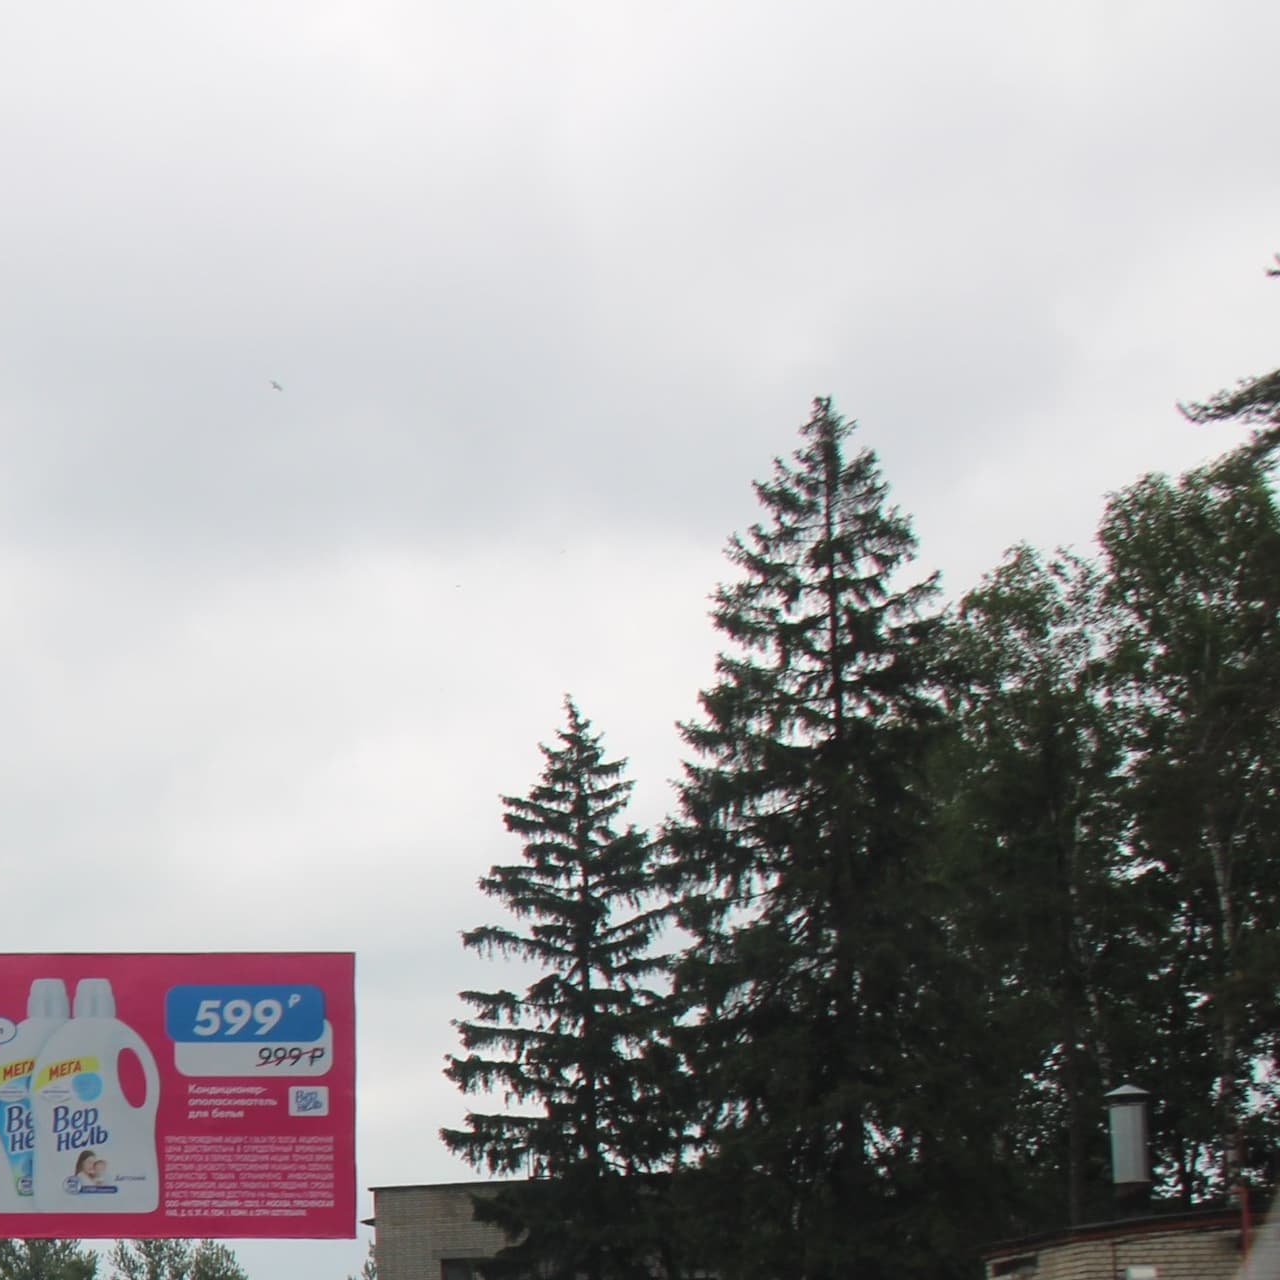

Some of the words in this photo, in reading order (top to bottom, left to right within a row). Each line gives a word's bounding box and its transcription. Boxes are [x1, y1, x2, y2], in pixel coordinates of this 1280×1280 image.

[193, 999, 283, 1036] 599
[258, 1047, 302, 1067] 999
[3, 1060, 35, 1081] МЕГА
[48, 1060, 82, 1081] МЕГА
[52, 1105, 98, 1133] Вер
[57, 1125, 108, 1151] нель
